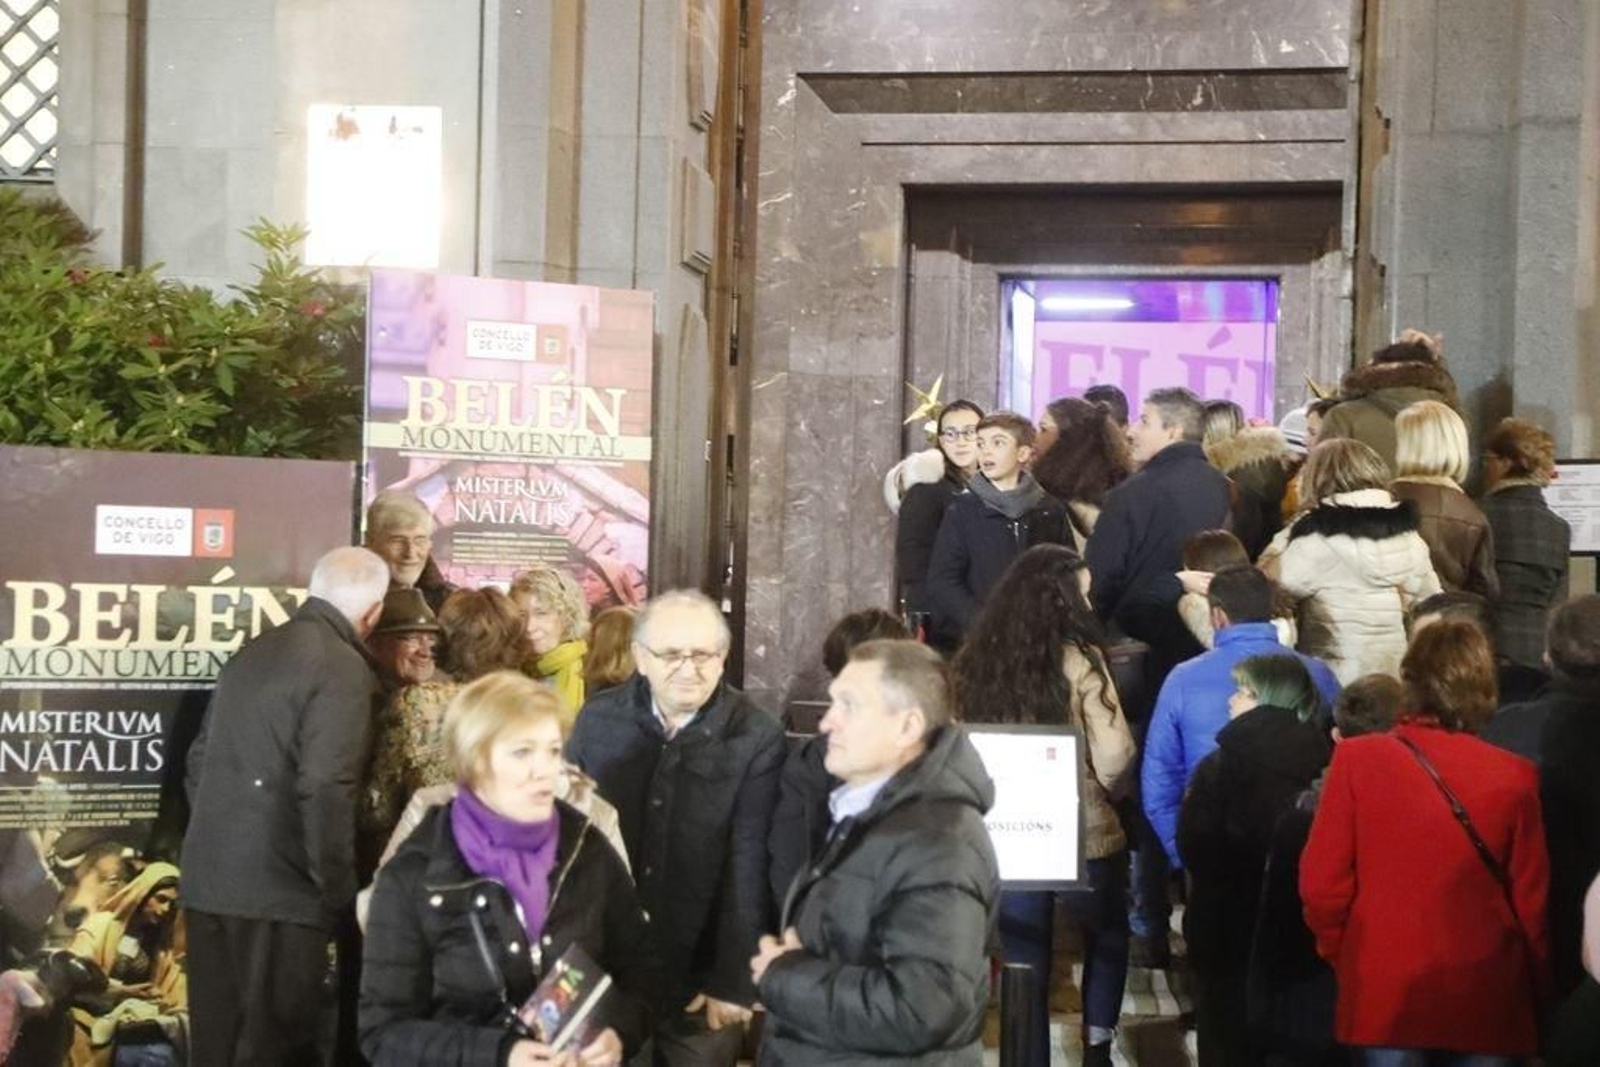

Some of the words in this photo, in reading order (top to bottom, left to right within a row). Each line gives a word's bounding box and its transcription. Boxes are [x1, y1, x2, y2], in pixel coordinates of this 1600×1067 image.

[472, 328, 531, 342] CONCELLO
[479, 340, 493, 351] DE
[497, 341, 525, 353] VIGO
[400, 371, 628, 438] BELÉN
[401, 426, 624, 457] MONUMENTAL
[455, 476, 569, 502] MISTERIVM
[104, 515, 185, 531] CONCELLO
[454, 499, 572, 527] NATALIS
[112, 531, 133, 544] DE
[138, 532, 175, 545] VIGO
[4, 648, 232, 677] MONUMEN
[0, 710, 162, 739] MISTERIVM
[0, 740, 164, 772] NATALIS
